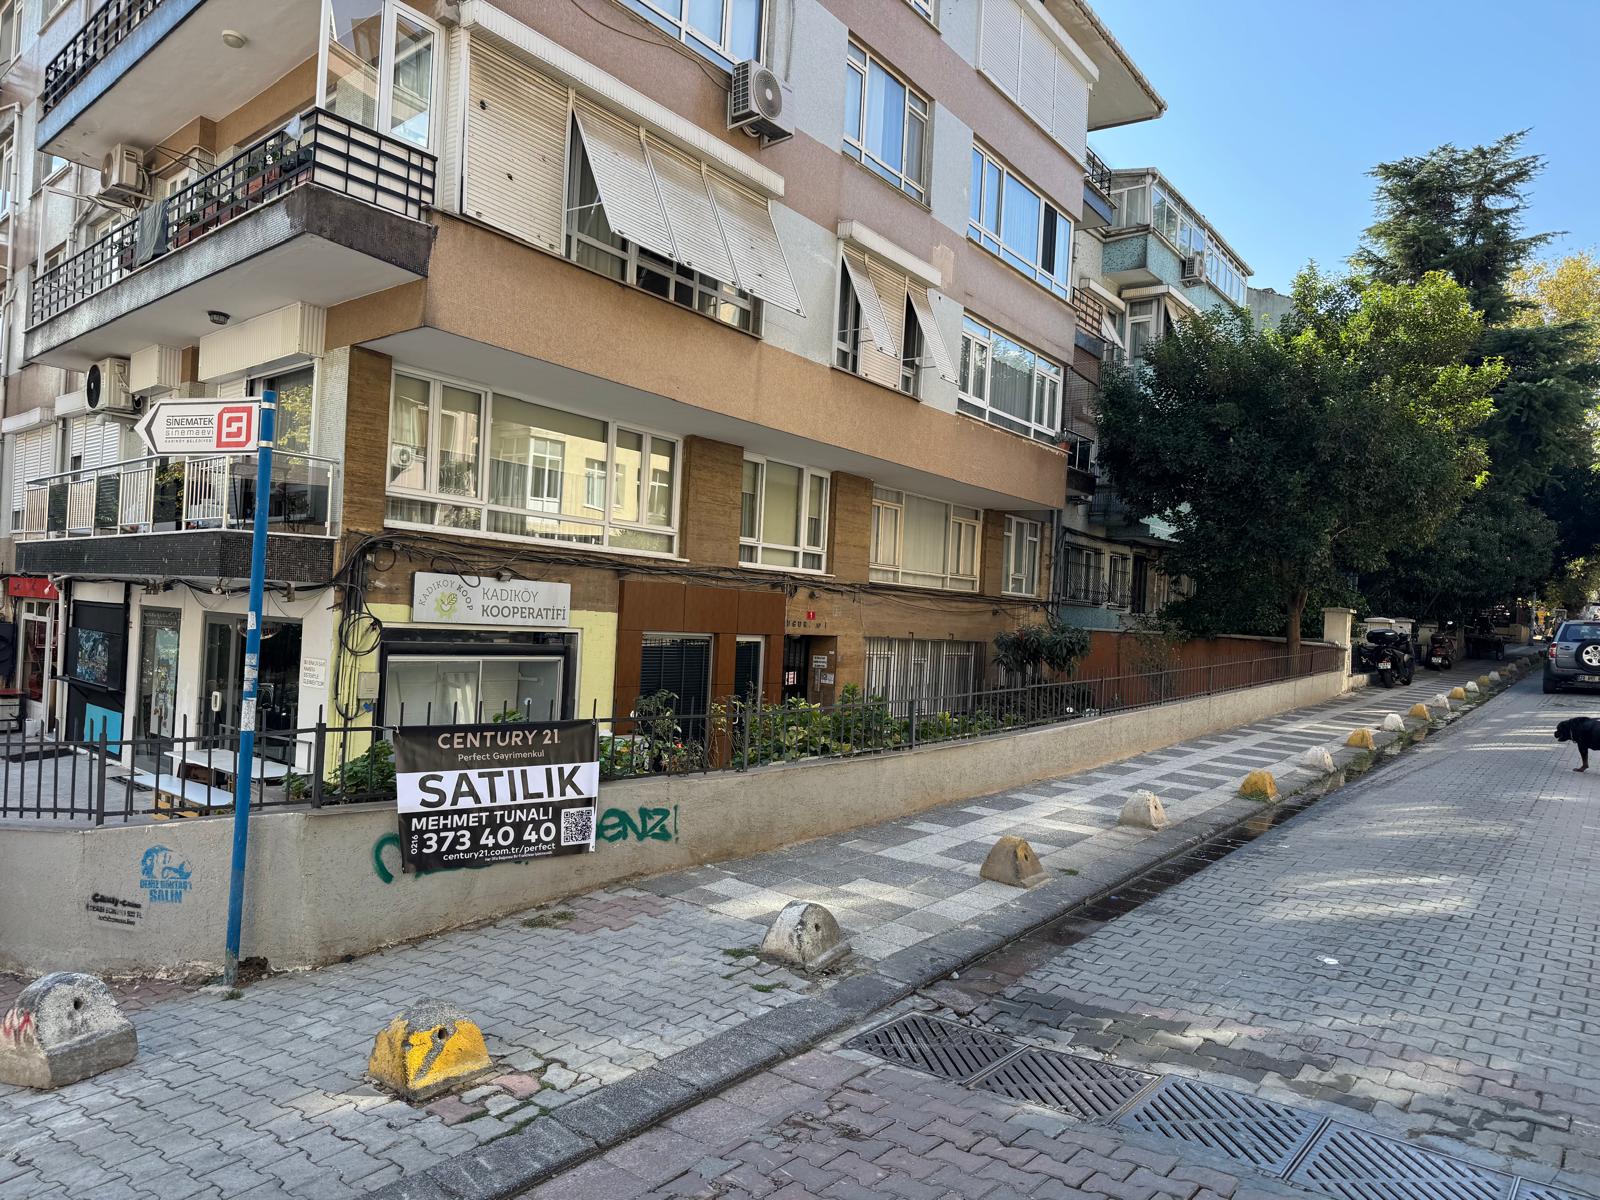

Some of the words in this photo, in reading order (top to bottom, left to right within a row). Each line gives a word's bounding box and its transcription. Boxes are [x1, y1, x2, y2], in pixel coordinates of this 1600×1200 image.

[165, 428, 214, 436] sinemaevi
[456, 584, 474, 611] KOOP
[482, 587, 539, 603] KADIKÖY
[481, 604, 566, 621] KOOPERATİFİ
[438, 730, 537, 749] CENTURY
[543, 729, 559, 745] 21
[458, 753, 490, 762] Perfect
[492, 750, 545, 762] Gayrimenkul
[418, 765, 584, 808] SATILIK
[411, 811, 487, 831] MEHMET
[494, 807, 552, 823] TUNALI
[410, 834, 418, 855] 0216
[422, 830, 471, 853] 373
[480, 826, 515, 848] 40
[523, 822, 556, 843] 40
[443, 842, 556, 861] century21.com.tr/perfect
